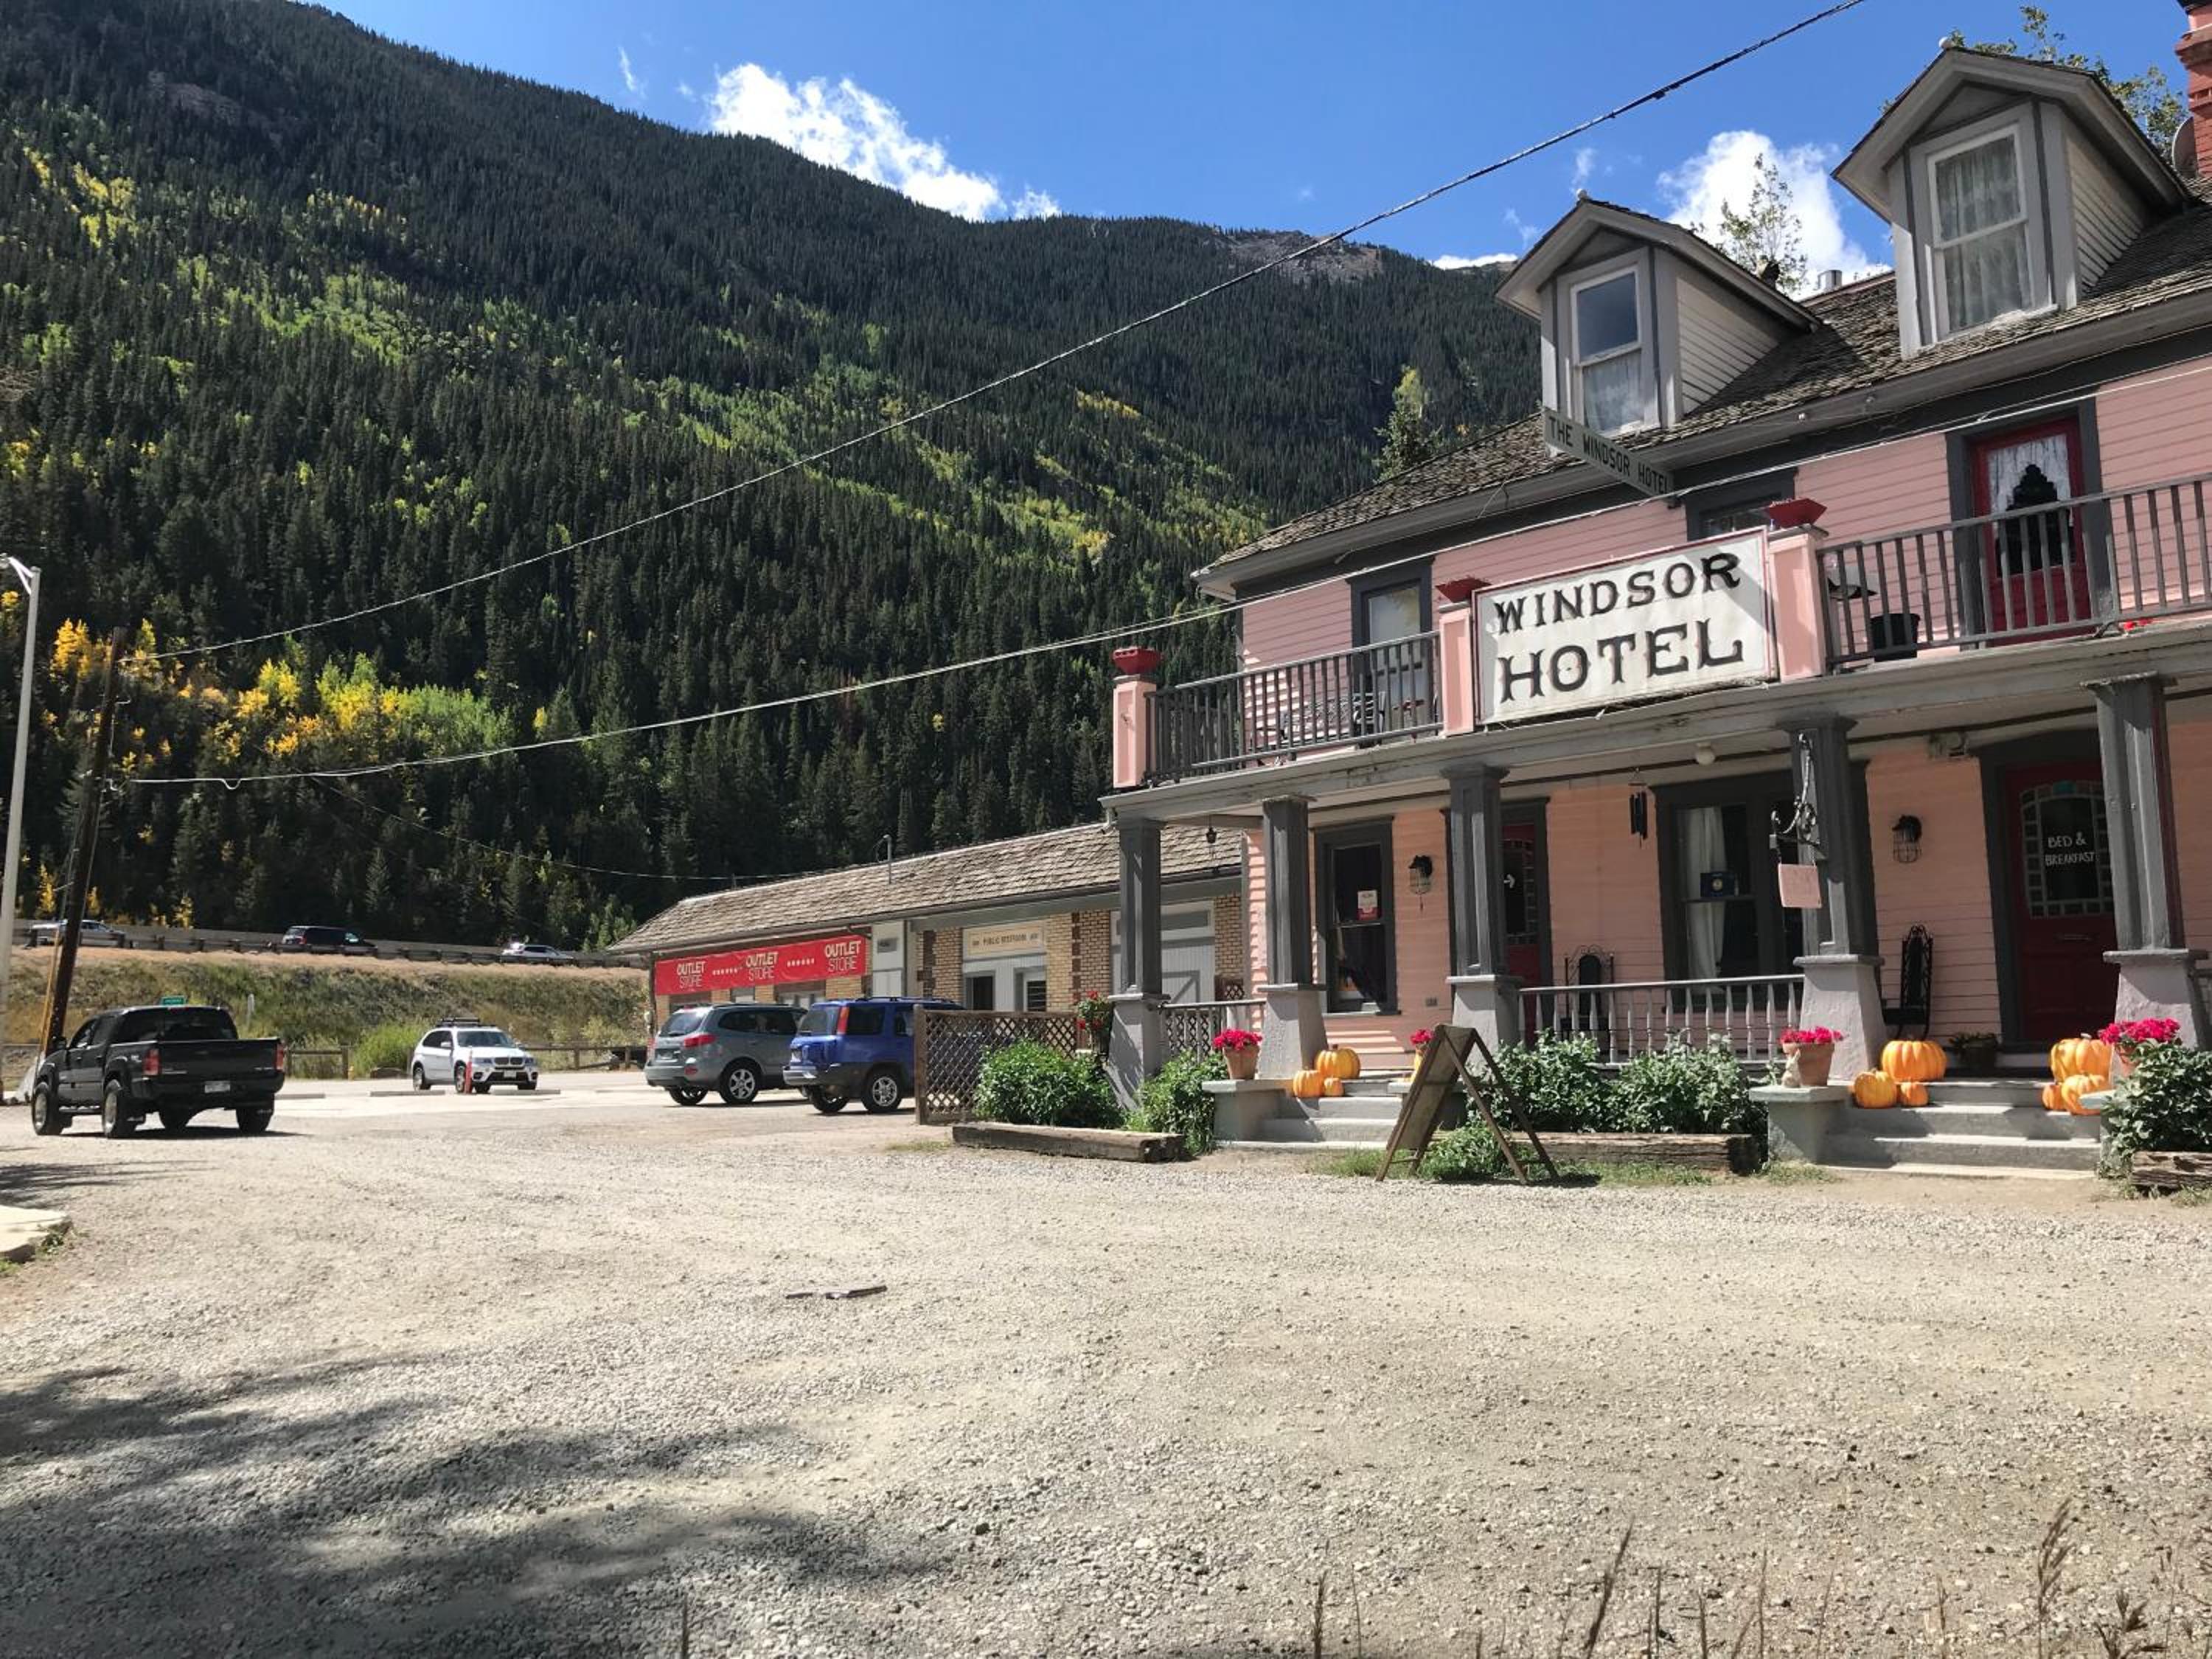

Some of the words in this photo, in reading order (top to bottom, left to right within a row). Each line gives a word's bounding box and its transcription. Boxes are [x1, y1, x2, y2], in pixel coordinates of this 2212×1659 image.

[1549, 416, 1573, 447] THE
[1583, 434, 1630, 476] WINDSOR
[1495, 552, 1740, 635] WINDSOR
[1498, 618, 1743, 703] HOTEL
[2048, 835, 2072, 848] BED
[2076, 831, 2087, 846] &
[2045, 852, 2095, 866] BREAKFAST
[824, 941, 861, 958] OUTLET
[745, 952, 779, 967] OUTLET
[827, 956, 857, 972] STORE
[677, 961, 706, 976] OUTLET
[748, 966, 774, 981] STORE
[679, 974, 702, 989] STORE
